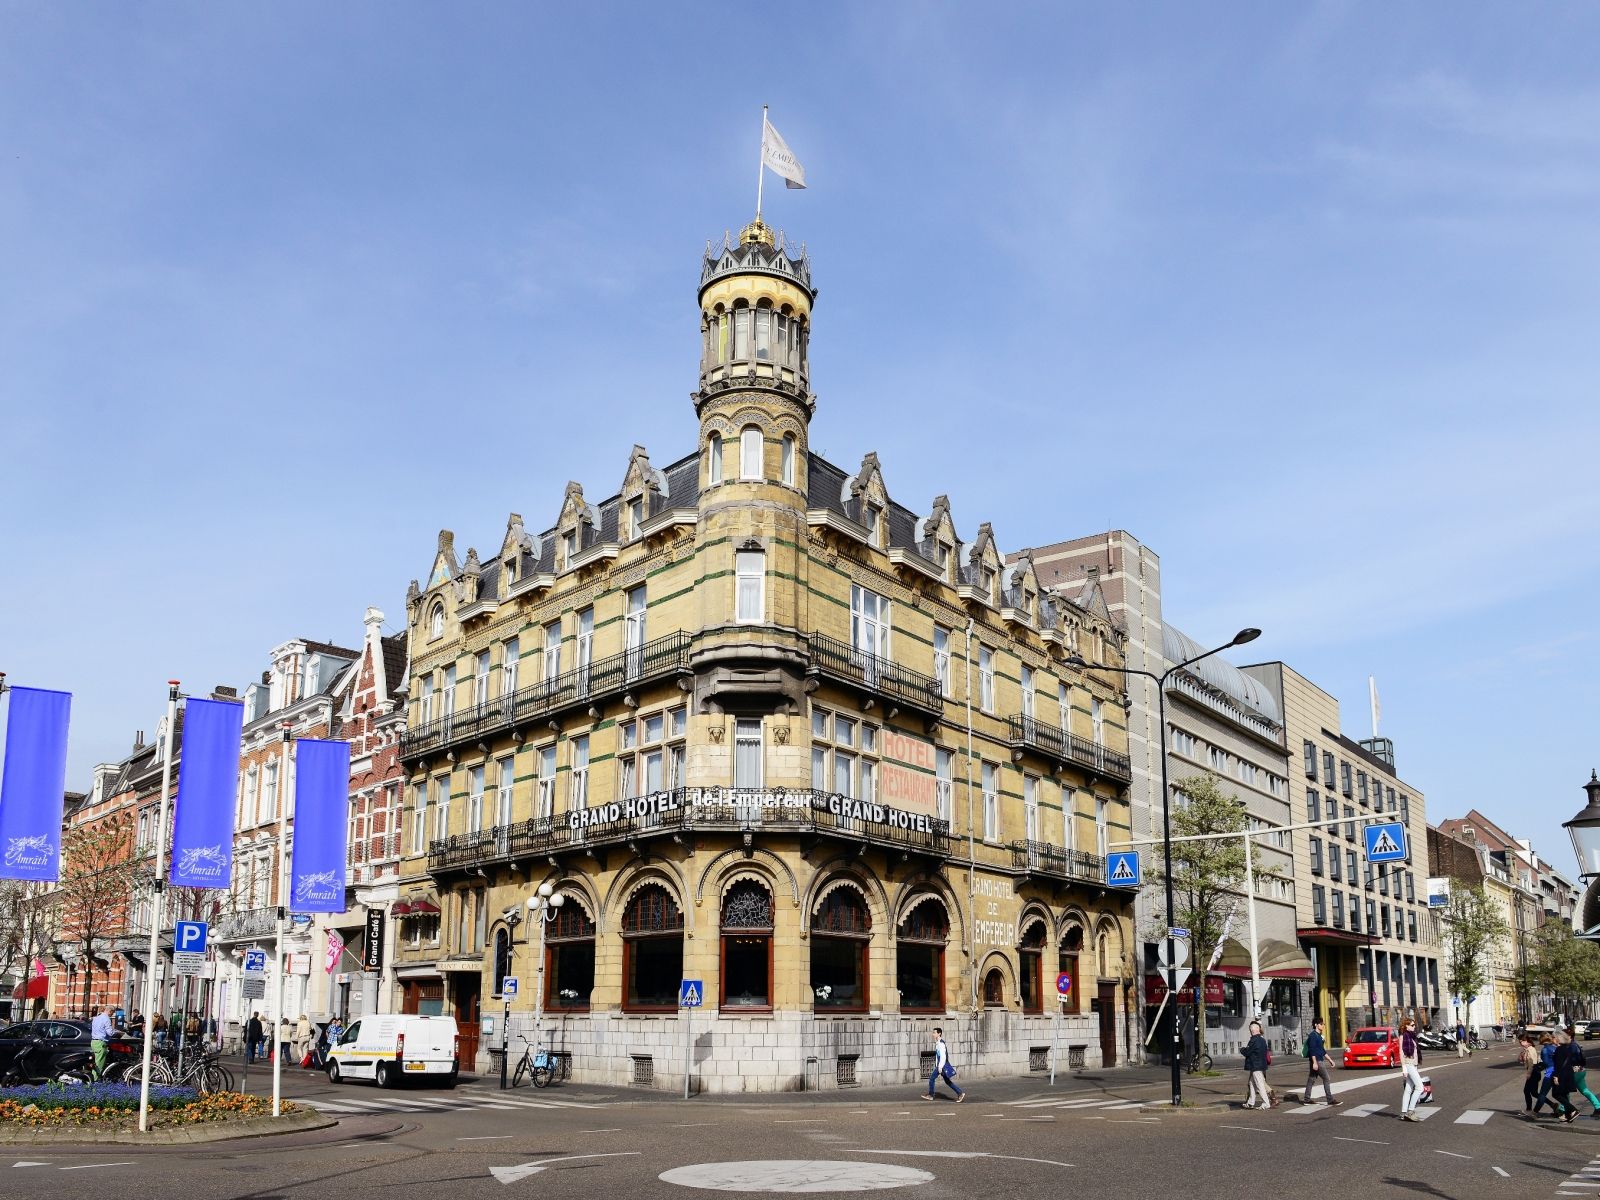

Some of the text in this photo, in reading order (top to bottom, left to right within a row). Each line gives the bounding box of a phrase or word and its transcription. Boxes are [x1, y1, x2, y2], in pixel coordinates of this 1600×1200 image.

[884, 733, 935, 768] HOTEL
[570, 791, 678, 830] GRAND HOTEL
[692, 789, 713, 806] de
[829, 796, 932, 833] GRAND HOTEL
[182, 925, 201, 949] P
[370, 919, 379, 966] Grand Café
[974, 920, 1014, 946] EMPEREUR
